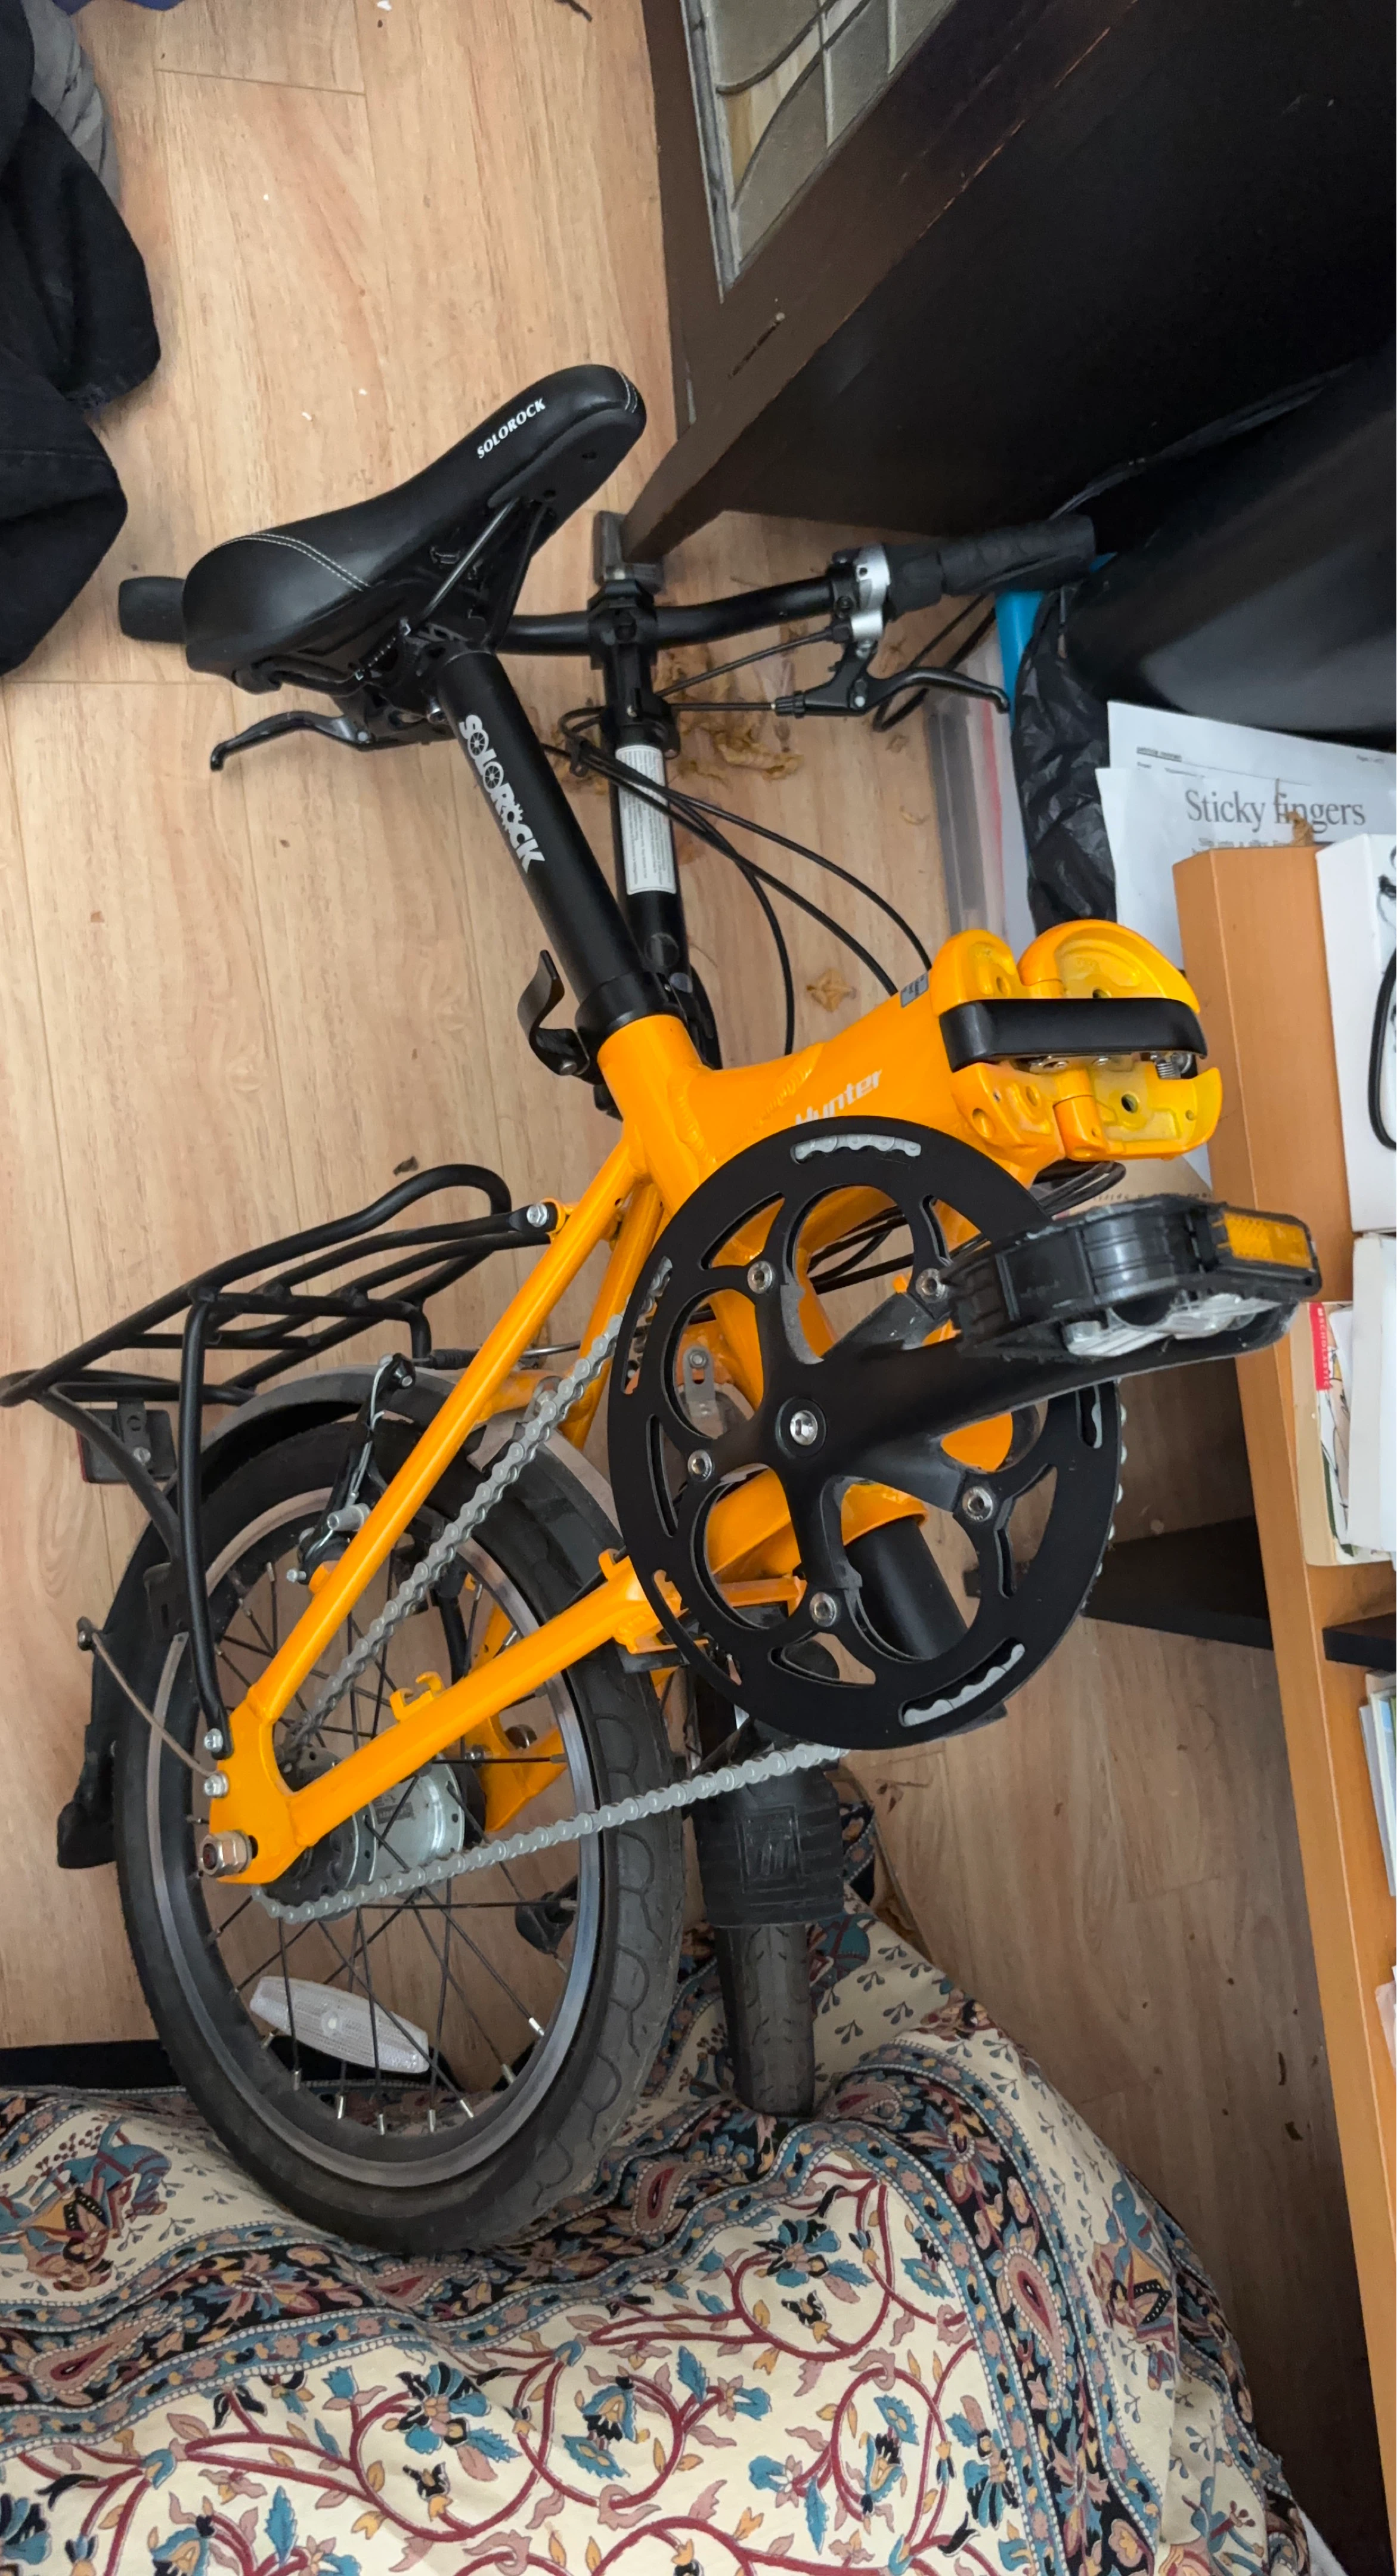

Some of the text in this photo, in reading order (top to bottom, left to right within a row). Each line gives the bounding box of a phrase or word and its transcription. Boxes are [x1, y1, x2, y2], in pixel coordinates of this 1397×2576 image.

[477, 398, 546, 459] SOLOROCK
[459, 714, 545, 874] SOLOROCK
[1184, 789, 1266, 833] Sticky
